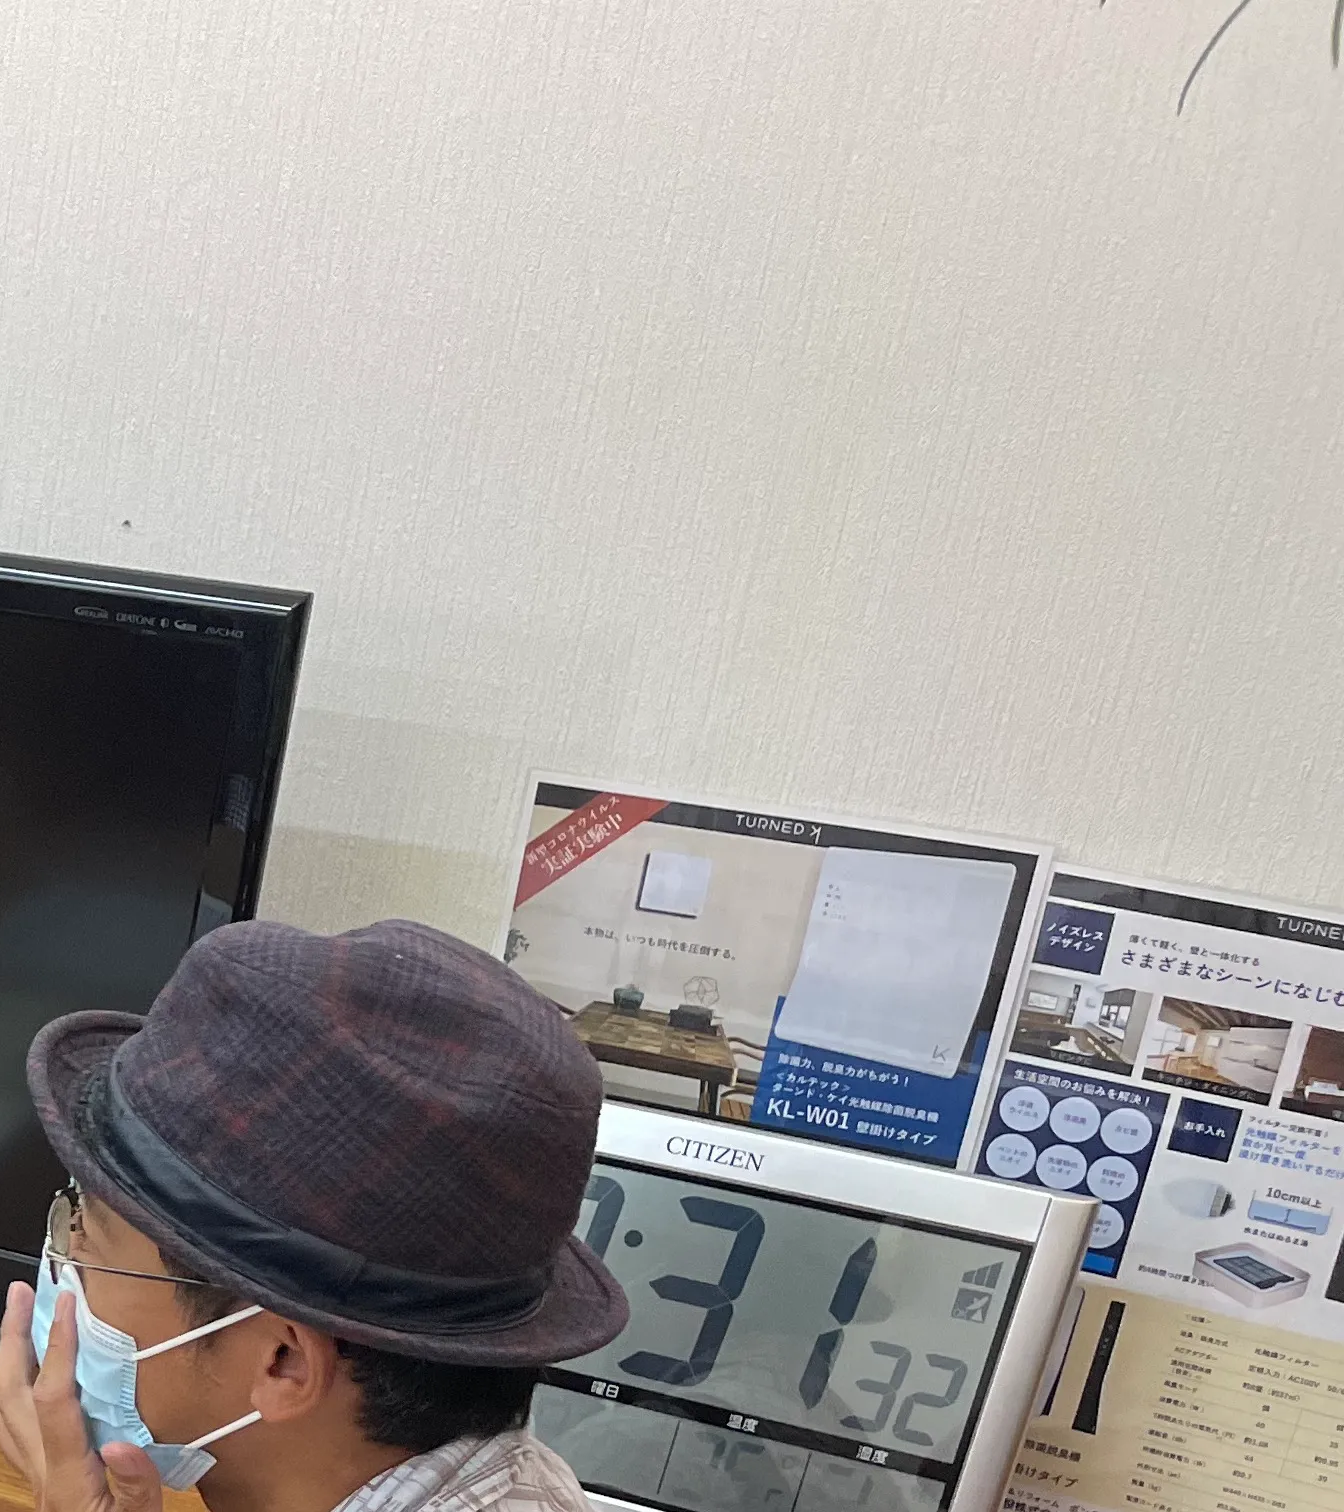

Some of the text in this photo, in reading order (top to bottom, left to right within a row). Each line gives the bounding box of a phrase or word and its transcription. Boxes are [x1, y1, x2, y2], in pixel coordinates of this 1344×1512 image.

[736, 814, 804, 836] TURNED
[1047, 923, 1104, 941] ノイズレス
[1278, 917, 1344, 939] TURNE
[584, 926, 736, 961] 本物は、いつも時代を圧倒する。
[1049, 936, 1096, 952] デザイン
[767, 1098, 938, 1145] KL-W01 壁掛けタイプ
[1183, 1121, 1226, 1138] お手入れ
[666, 1136, 765, 1173] CITIZEN
[1266, 1187, 1322, 1209] 10cm以上
[591, 1380, 620, 1400] 曜日
[839, 1340, 968, 1448] 32
[727, 1413, 759, 1434] 温度
[857, 1444, 889, 1466] 湿度
